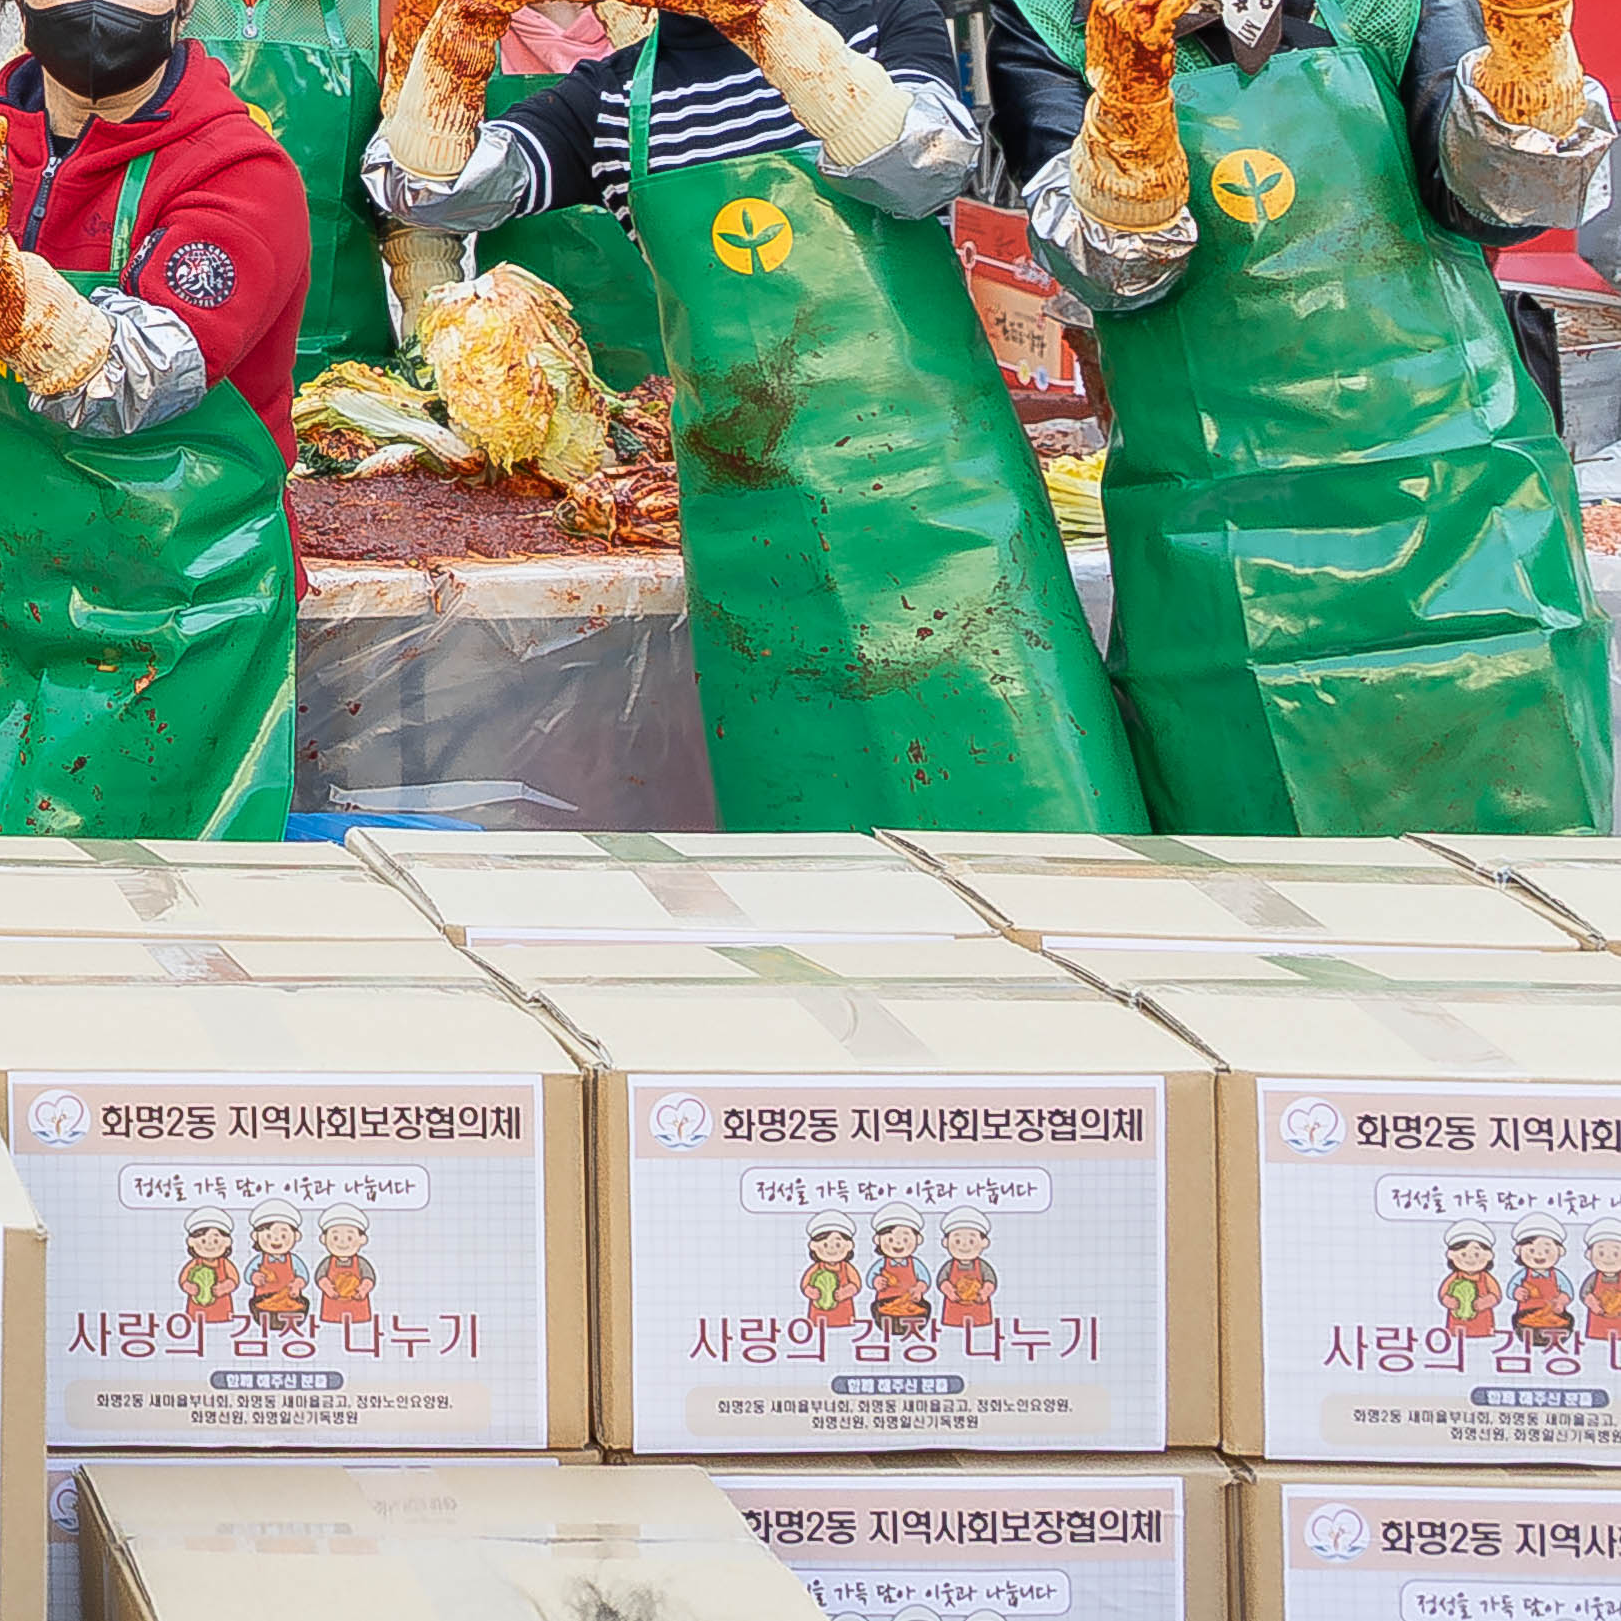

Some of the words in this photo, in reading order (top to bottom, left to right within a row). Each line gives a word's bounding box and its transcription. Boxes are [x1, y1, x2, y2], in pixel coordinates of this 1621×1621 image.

[100, 1105, 216, 1140] 화명2동
[228, 1105, 522, 1140] 지역사회보장협의체
[722, 1109, 838, 1143] 화명2동
[851, 1108, 1143, 1143] 지역사회보장협의체
[1356, 1115, 1475, 1151] 화명2동
[135, 1176, 187, 1199] 정성을
[193, 1177, 228, 1199] 가득
[236, 1177, 274, 1196] 담아
[284, 1177, 335, 1200] 이웃과
[344, 1177, 415, 1202] 나눕니다
[756, 1180, 807, 1203] 정성을
[817, 1182, 850, 1203] 가득
[857, 1182, 896, 1201] 담아
[905, 1181, 957, 1204] 이웃과
[966, 1182, 1037, 1205] 나눕니다
[1392, 1188, 1446, 1213] 정성을
[1453, 1190, 1488, 1212] 가득
[1498, 1190, 1537, 1210] 담아
[1547, 1190, 1598, 1215] 이웃과
[68, 1313, 204, 1358] 사랑의
[229, 1314, 321, 1359] 김장
[344, 1314, 478, 1358] 나누기
[690, 1318, 826, 1362] 사랑의
[851, 1318, 941, 1362] 김장
[965, 1318, 1099, 1362] 나누기
[1324, 1325, 1465, 1373] 사랑의
[1490, 1329, 1585, 1375] 김장
[869, 1509, 1162, 1545] 지역사회보장협의체
[1381, 1520, 1502, 1556] 화명2동
[1515, 1522, 1621, 1559] 지역사
[835, 1585, 870, 1609] 가득
[877, 1586, 917, 1605] 담아
[926, 1585, 977, 1609] 이웃과
[986, 1584, 1058, 1609] 나눕니다
[1416, 1592, 1472, 1620] 정성을
[1480, 1594, 1514, 1619] 가득
[1524, 1597, 1565, 1617] 담아
